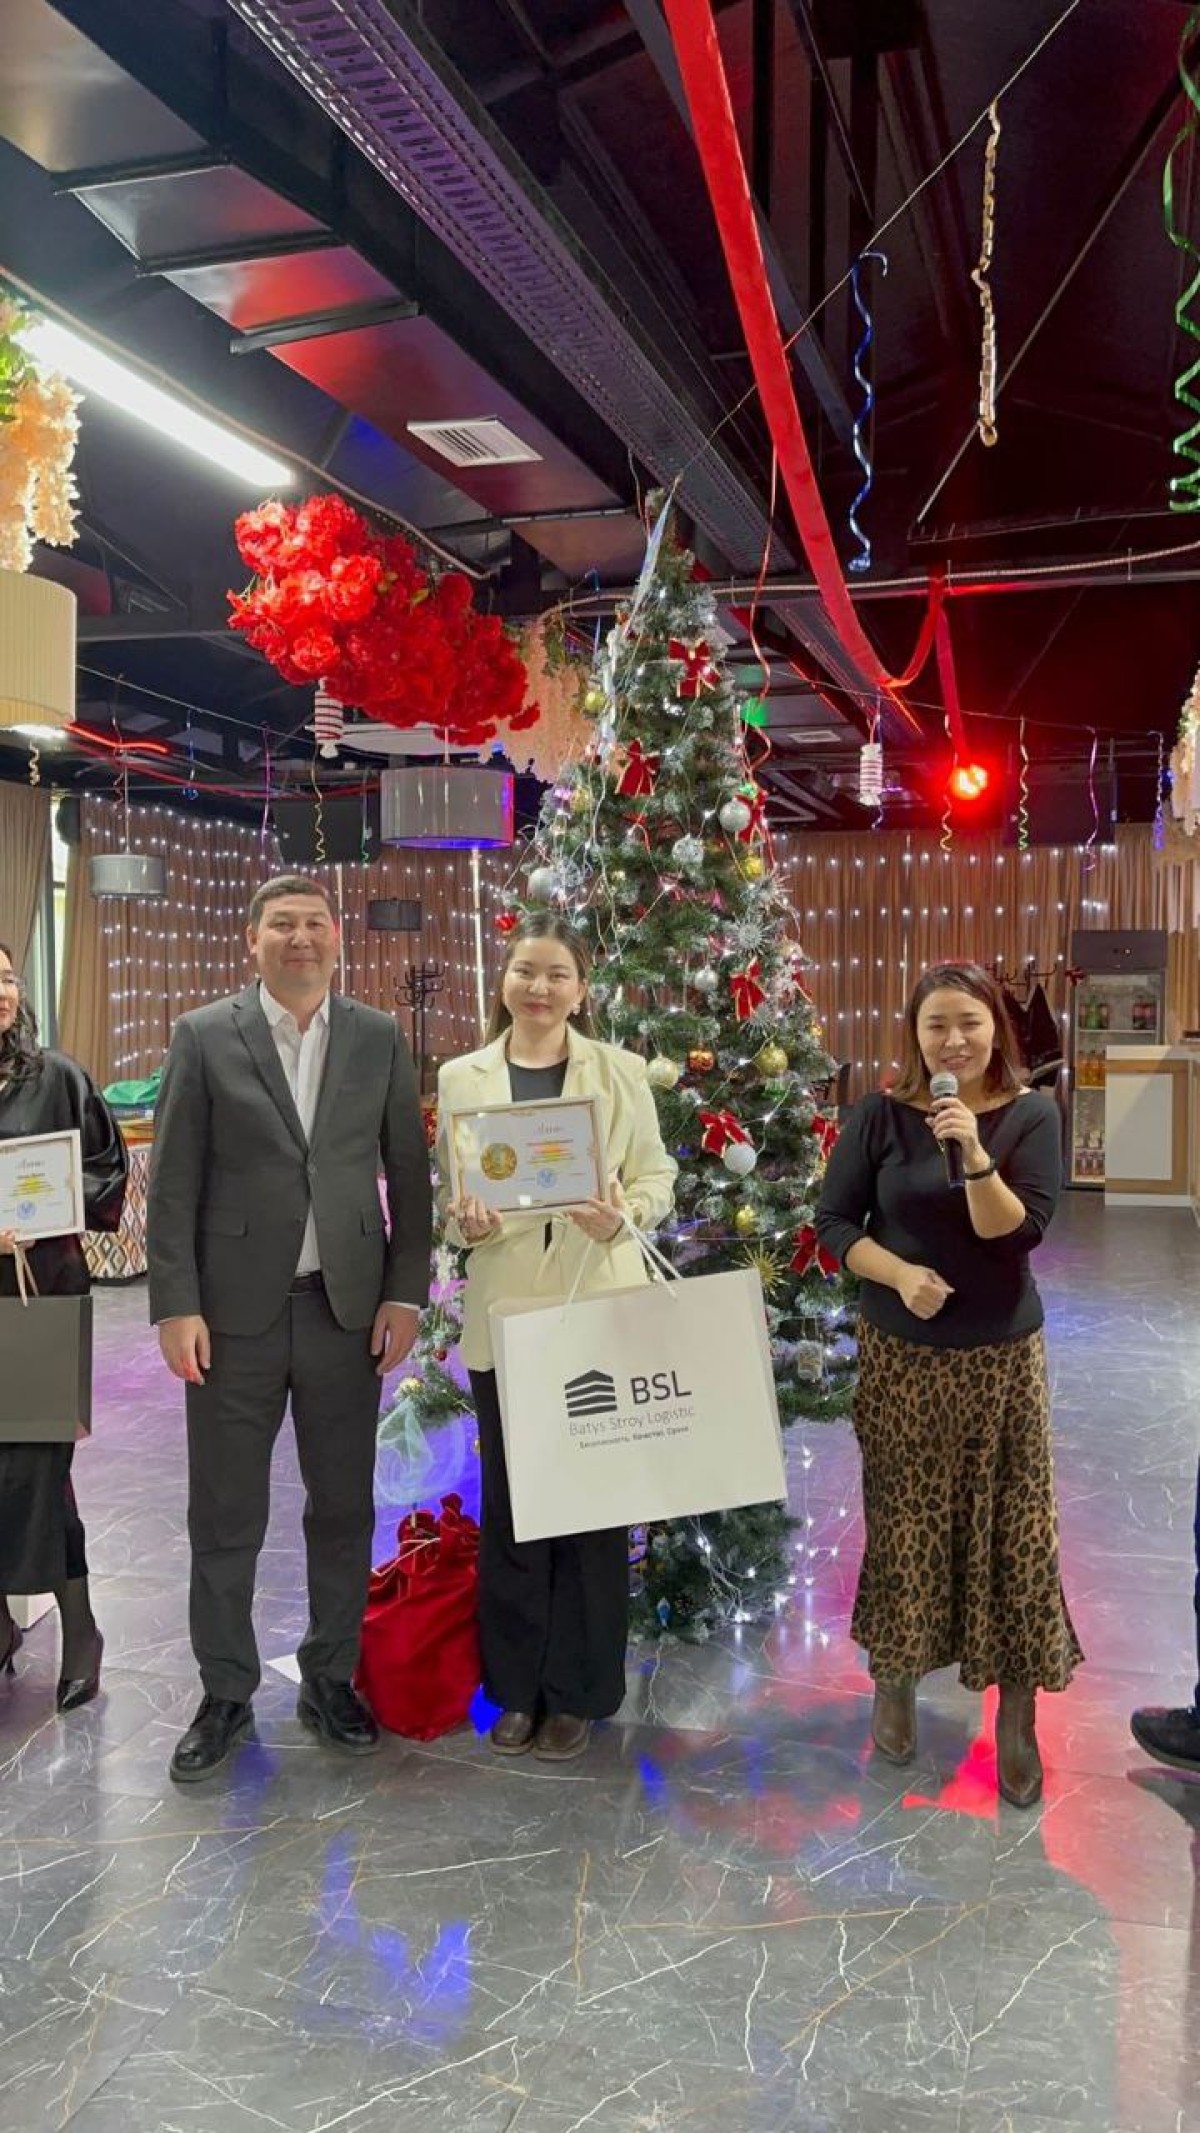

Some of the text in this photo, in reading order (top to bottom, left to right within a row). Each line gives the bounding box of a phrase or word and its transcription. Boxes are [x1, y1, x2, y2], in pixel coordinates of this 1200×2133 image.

[631, 1370, 692, 1404] BSL
[569, 1407, 695, 1437] Batys Stroy Logistic
